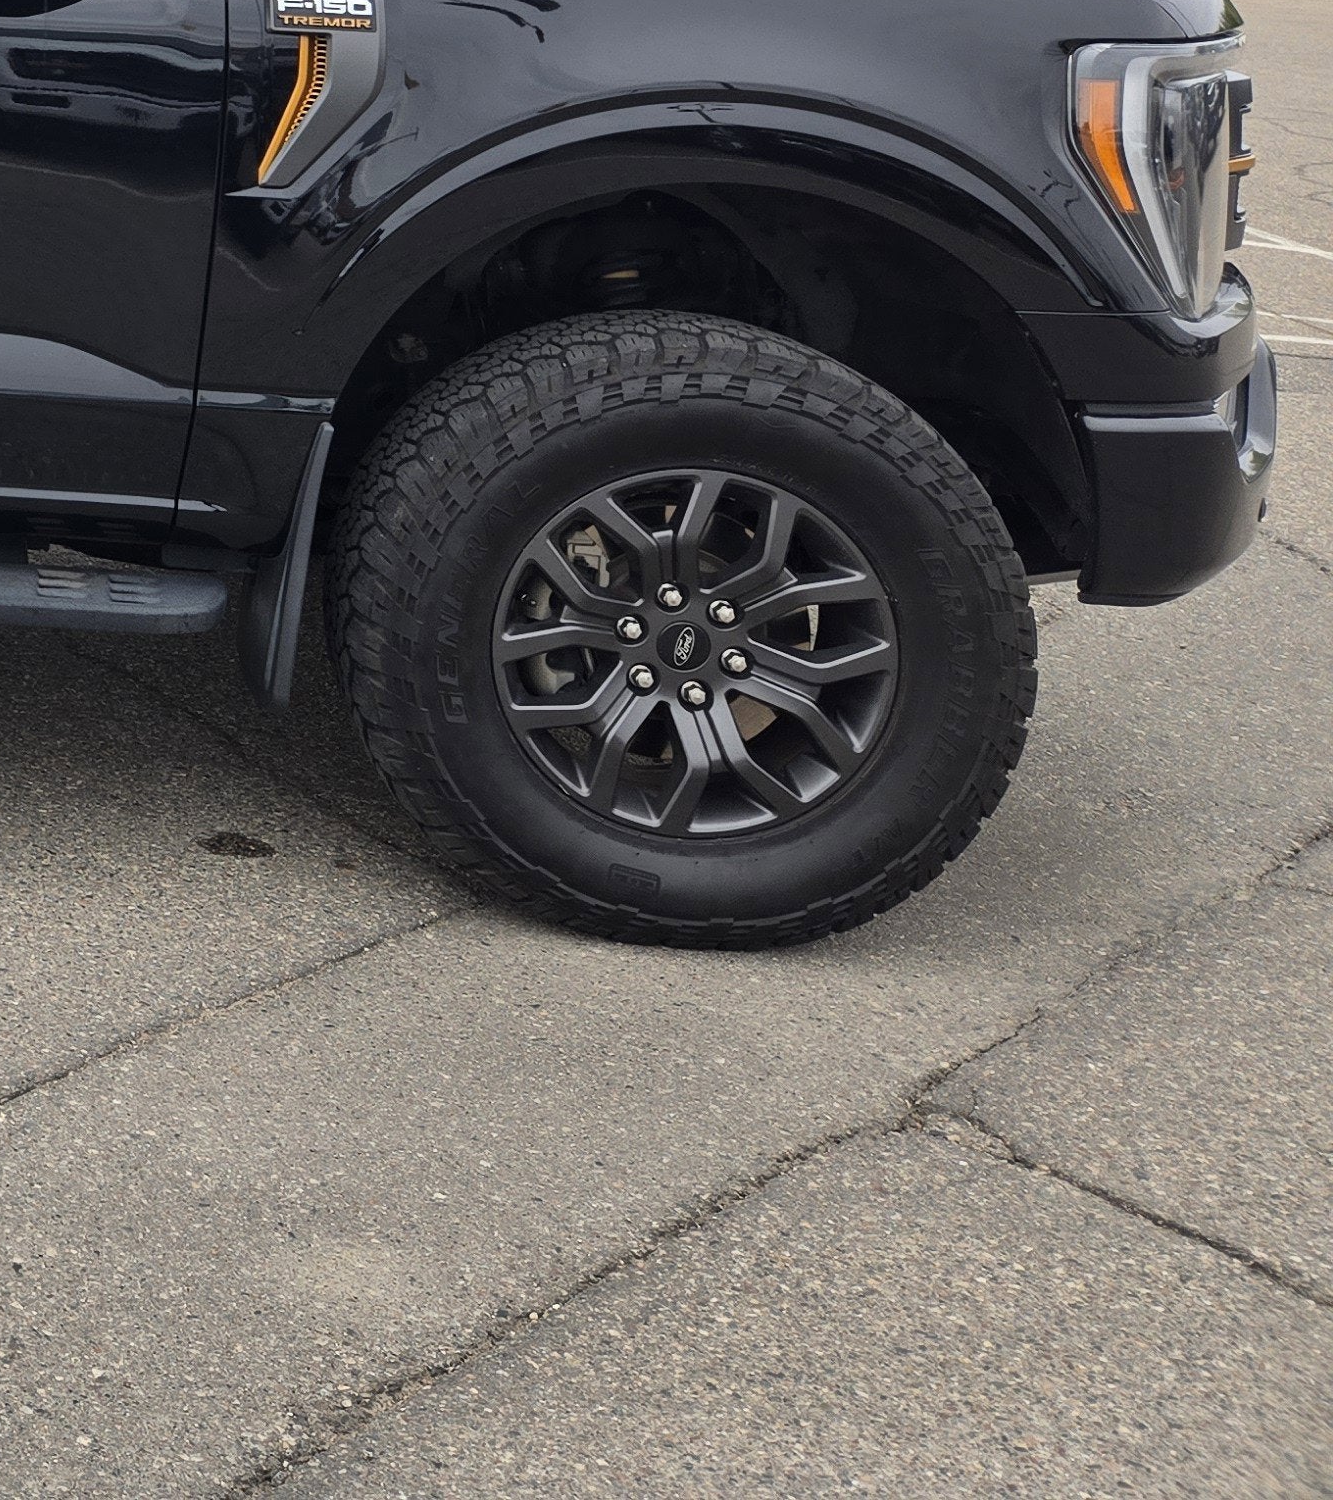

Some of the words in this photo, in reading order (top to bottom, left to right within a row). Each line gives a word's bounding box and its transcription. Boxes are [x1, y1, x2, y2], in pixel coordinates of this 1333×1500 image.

[279, 14, 372, 29] TREMOR
[435, 482, 541, 725] GENERAL
[907, 549, 977, 803] GRABBER
